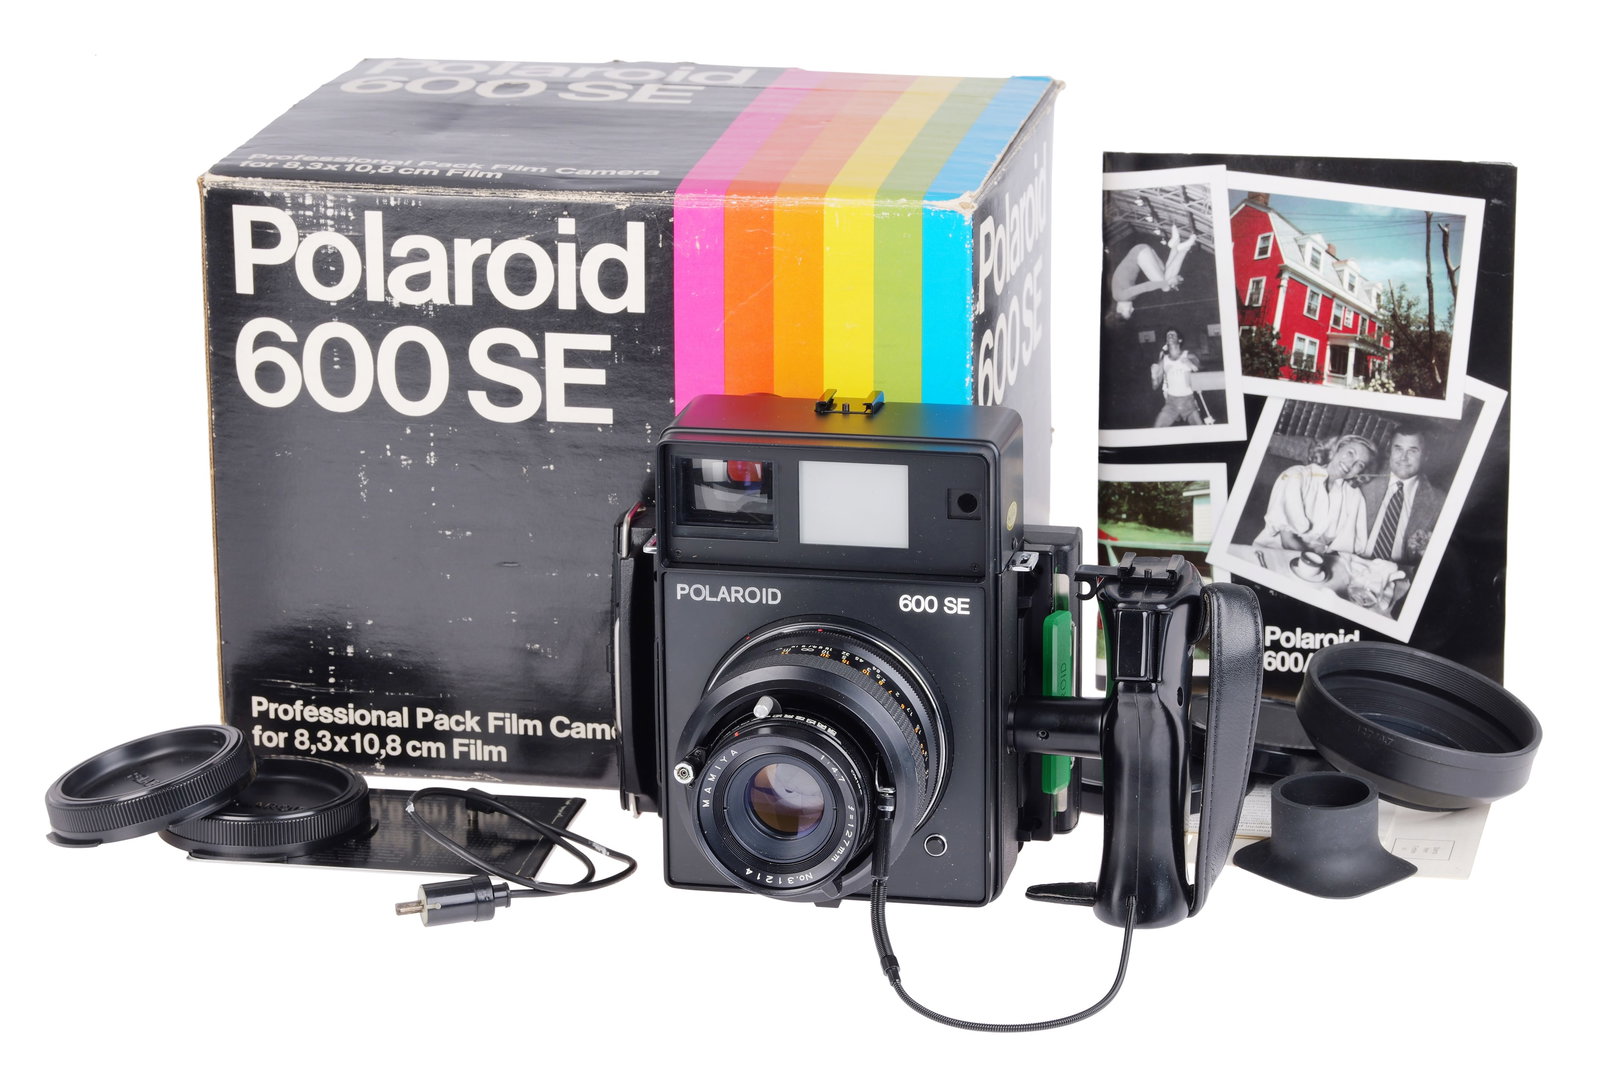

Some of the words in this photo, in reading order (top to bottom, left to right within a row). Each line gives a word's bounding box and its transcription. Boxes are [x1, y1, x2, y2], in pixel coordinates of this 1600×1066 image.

[340, 76, 547, 99] 600
[557, 80, 705, 104] SE
[364, 60, 759, 85] Polaroid
[239, 159, 280, 169] for
[446, 168, 504, 180] Film
[247, 153, 413, 168] Professional
[414, 159, 483, 171] Pack
[491, 163, 547, 174] Film
[555, 167, 660, 177] Camera
[979, 141, 1047, 315] Polaroid
[231, 203, 646, 314] Polaroid
[977, 294, 1020, 407] 600
[1022, 254, 1043, 367] SE
[235, 316, 450, 417] 600
[467, 328, 614, 425] SE
[676, 583, 782, 605] POLAROID
[898, 594, 938, 613] 600
[943, 596, 971, 615] SE
[1264, 625, 1360, 650] Polaroid
[251, 695, 409, 729] Professional
[416, 707, 482, 733] Pack
[488, 712, 543, 736] Film
[252, 725, 288, 748] for
[406, 739, 446, 758] cm
[453, 738, 508, 762] Film
[702, 749, 739, 808] MAMIYA
